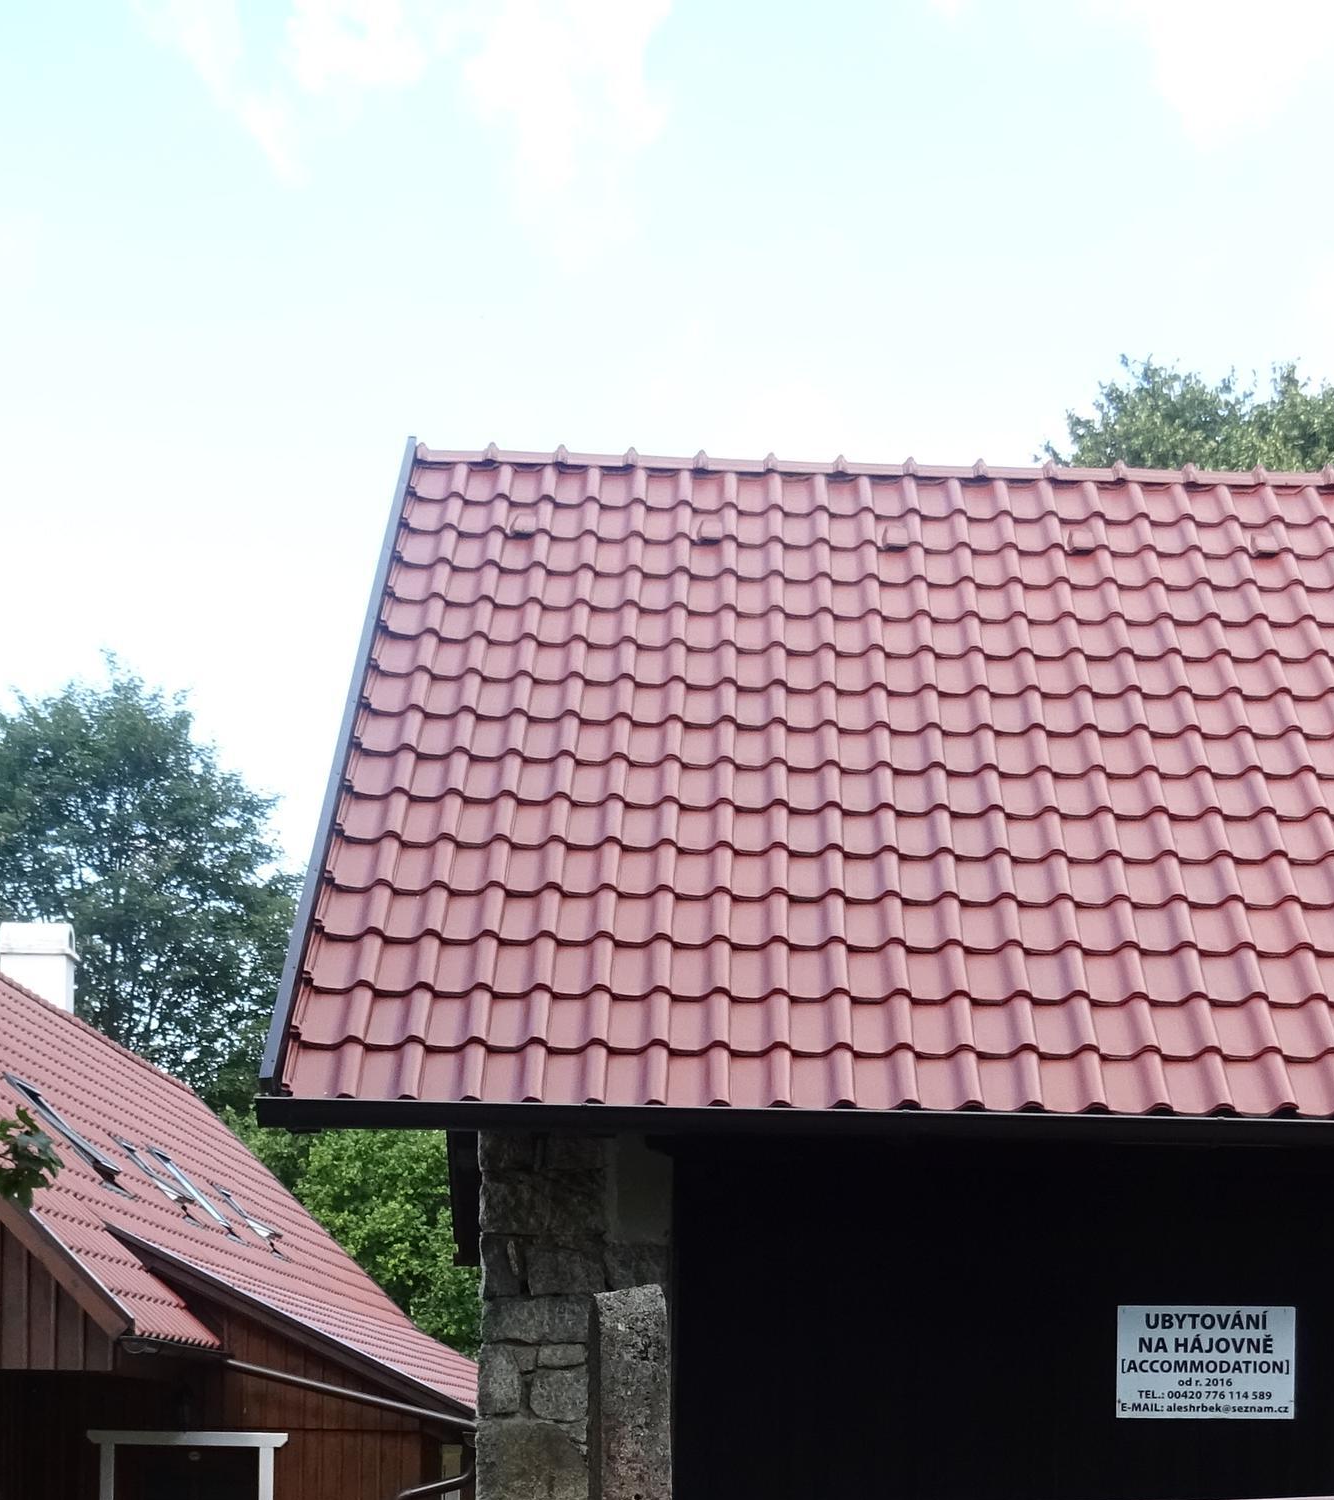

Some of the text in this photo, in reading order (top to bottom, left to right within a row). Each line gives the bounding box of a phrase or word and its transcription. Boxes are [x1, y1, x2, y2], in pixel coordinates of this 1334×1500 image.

[1145, 1310, 1269, 1330] UBYTOVÁNÍ
[1138, 1334, 1273, 1354] NA HÁJOVNĚ
[1121, 1358, 1290, 1375] [ACCOMMODATION]
[1178, 1378, 1233, 1387] od r. 2016
[1137, 1389, 1272, 1400] TEL.: 00420 776 114 589
[1121, 1403, 1289, 1414] E-MAIL: aleshrbek@seznam.cz
